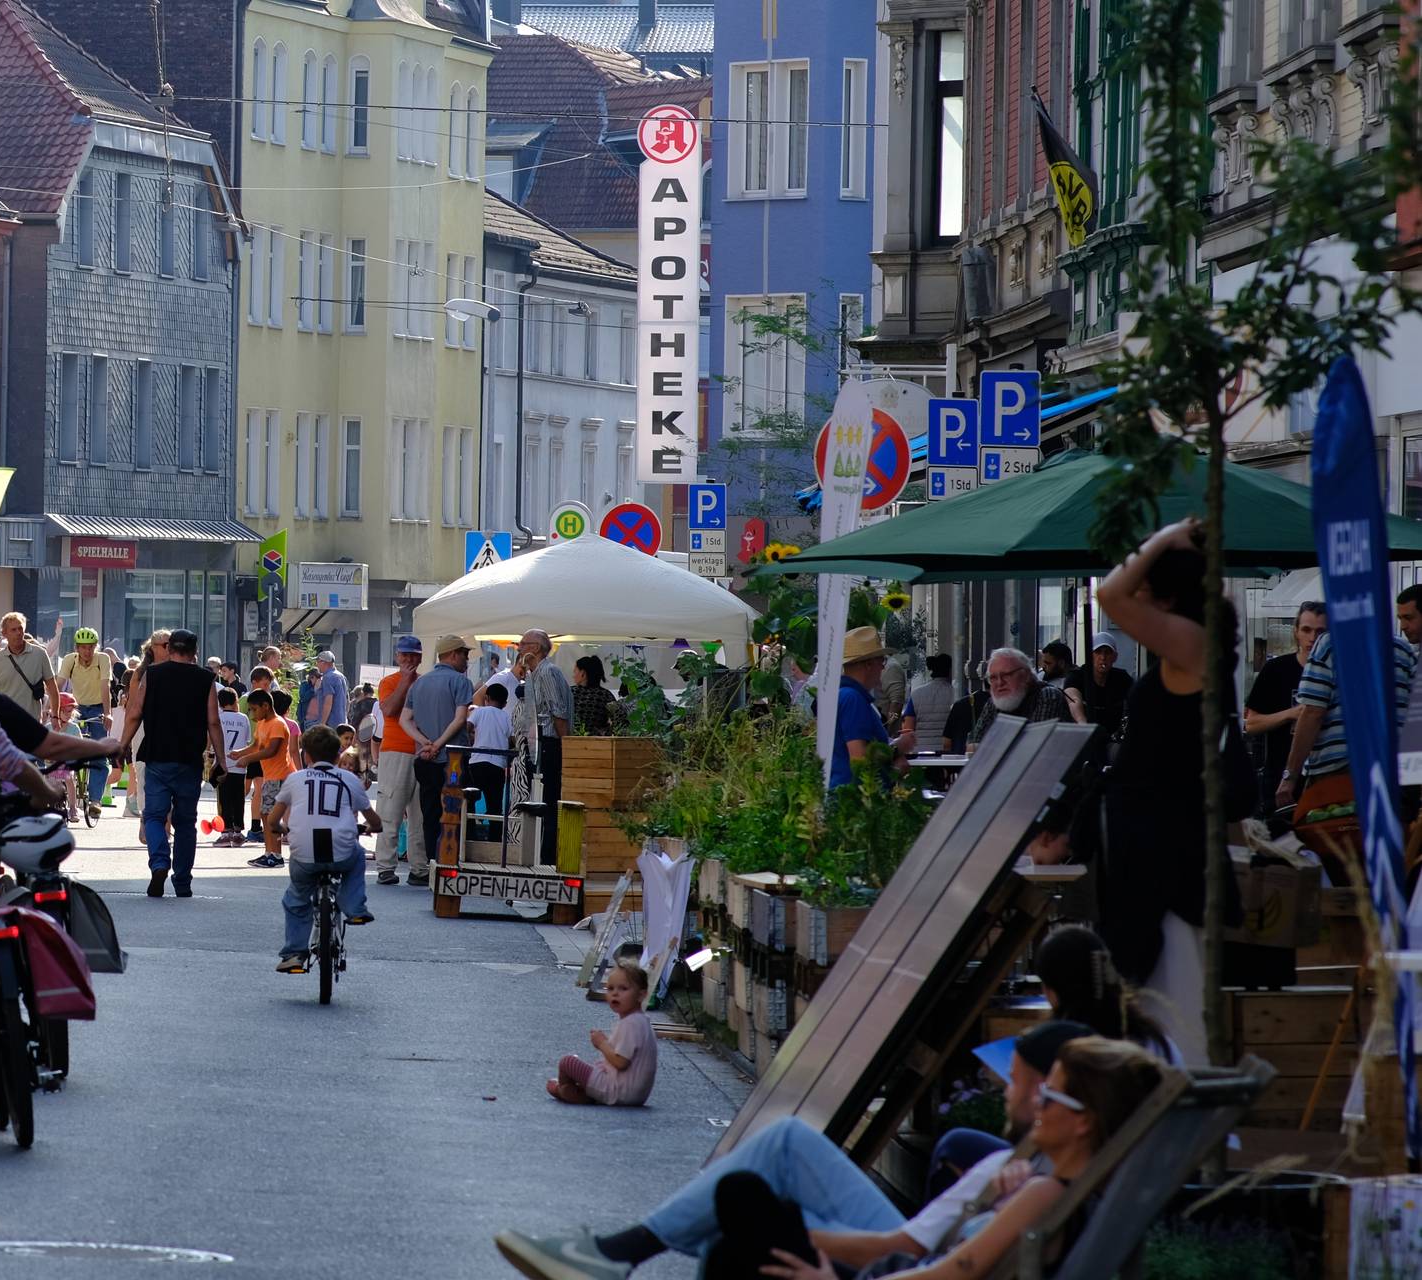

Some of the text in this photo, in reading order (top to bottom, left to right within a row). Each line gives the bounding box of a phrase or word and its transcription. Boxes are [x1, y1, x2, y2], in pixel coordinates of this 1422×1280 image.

[650, 178, 689, 475] APOTHEKE
[994, 382, 1026, 437] P
[939, 408, 967, 457] P
[1004, 461, 1031, 473] 2 Std
[956, 480, 971, 490] Std
[698, 490, 717, 524] P
[78, 546, 129, 559] SPIELHALLE
[692, 557, 724, 566] werktags
[227, 730, 239, 750] 7
[304, 779, 344, 817] 10
[442, 875, 574, 903] KOPENHAGEN
